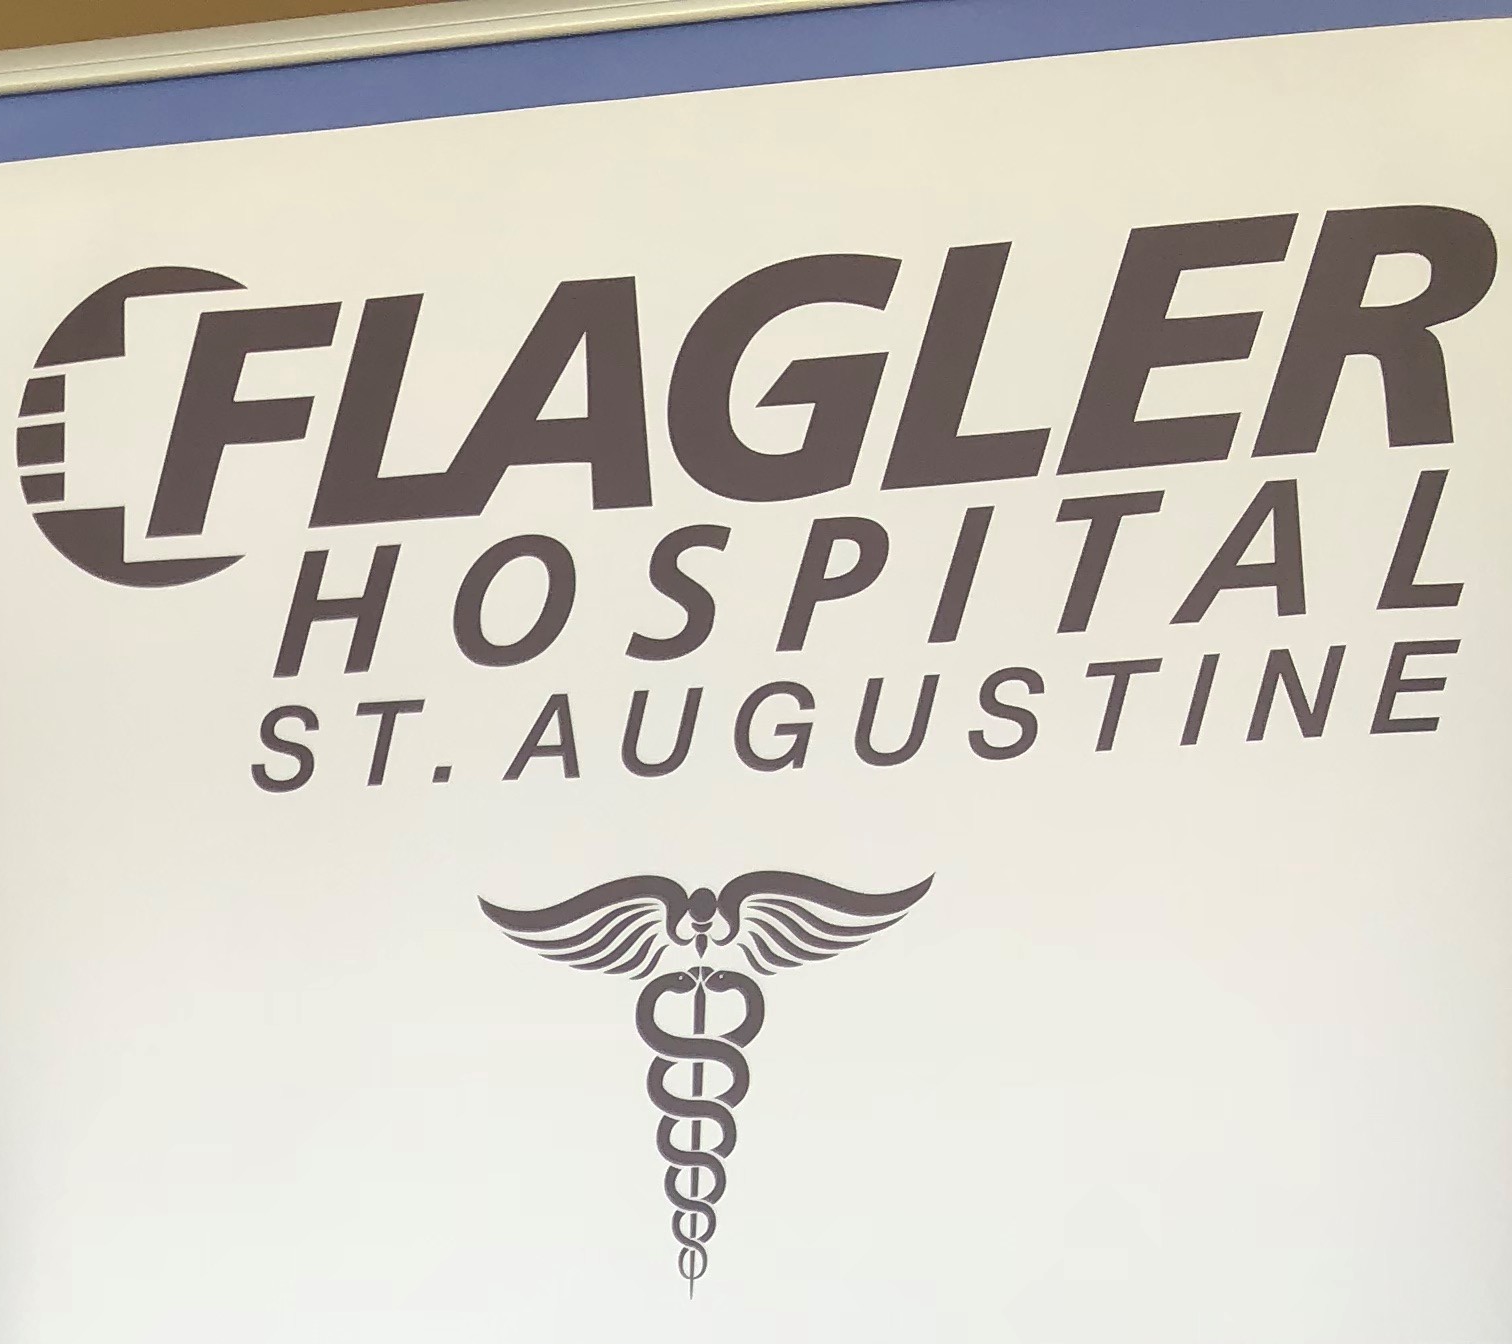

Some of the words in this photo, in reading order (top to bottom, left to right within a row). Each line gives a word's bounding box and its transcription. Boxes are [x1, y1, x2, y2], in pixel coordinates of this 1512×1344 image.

[145, 204, 1498, 538] FLAGLER
[273, 469, 1465, 678] HOSPITAL
[251, 699, 452, 793] ST.
[502, 639, 1461, 780] AUGUSTINE
